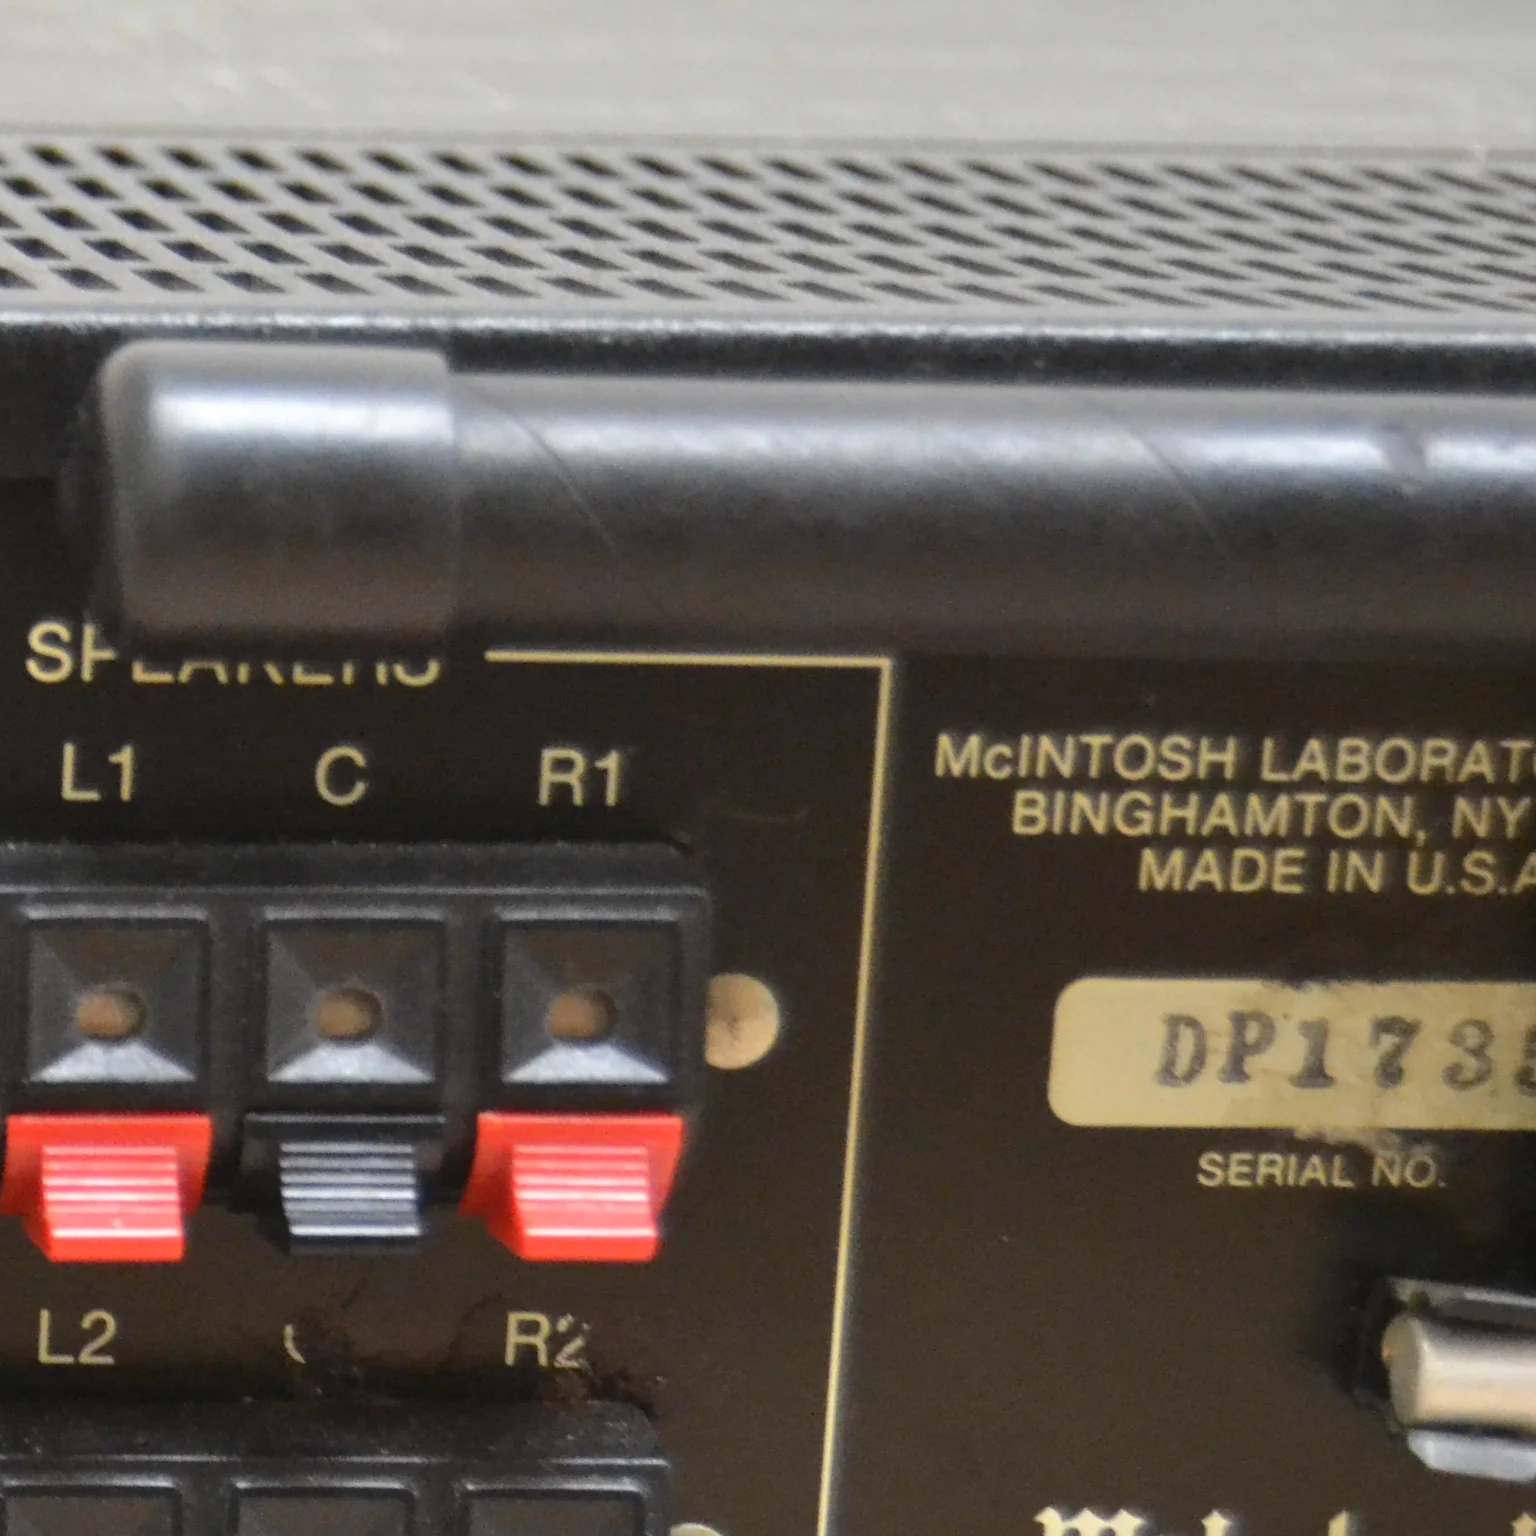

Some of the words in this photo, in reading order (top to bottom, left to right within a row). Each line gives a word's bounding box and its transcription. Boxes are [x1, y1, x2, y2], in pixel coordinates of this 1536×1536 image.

[62, 742, 133, 800] L1
[315, 745, 366, 805] C
[539, 747, 621, 805] R1
[936, 733, 1237, 781] McINTOSH
[1261, 737, 1536, 783] LABORAT
[1013, 789, 1426, 845] BINGHAMTON,
[1452, 796, 1530, 838] NY
[1139, 847, 1306, 893] MADE
[1328, 850, 1384, 892] IN
[1197, 1152, 1354, 1187] SERIAL
[1371, 1153, 1447, 1188] NO.
[38, 1309, 117, 1364] L2
